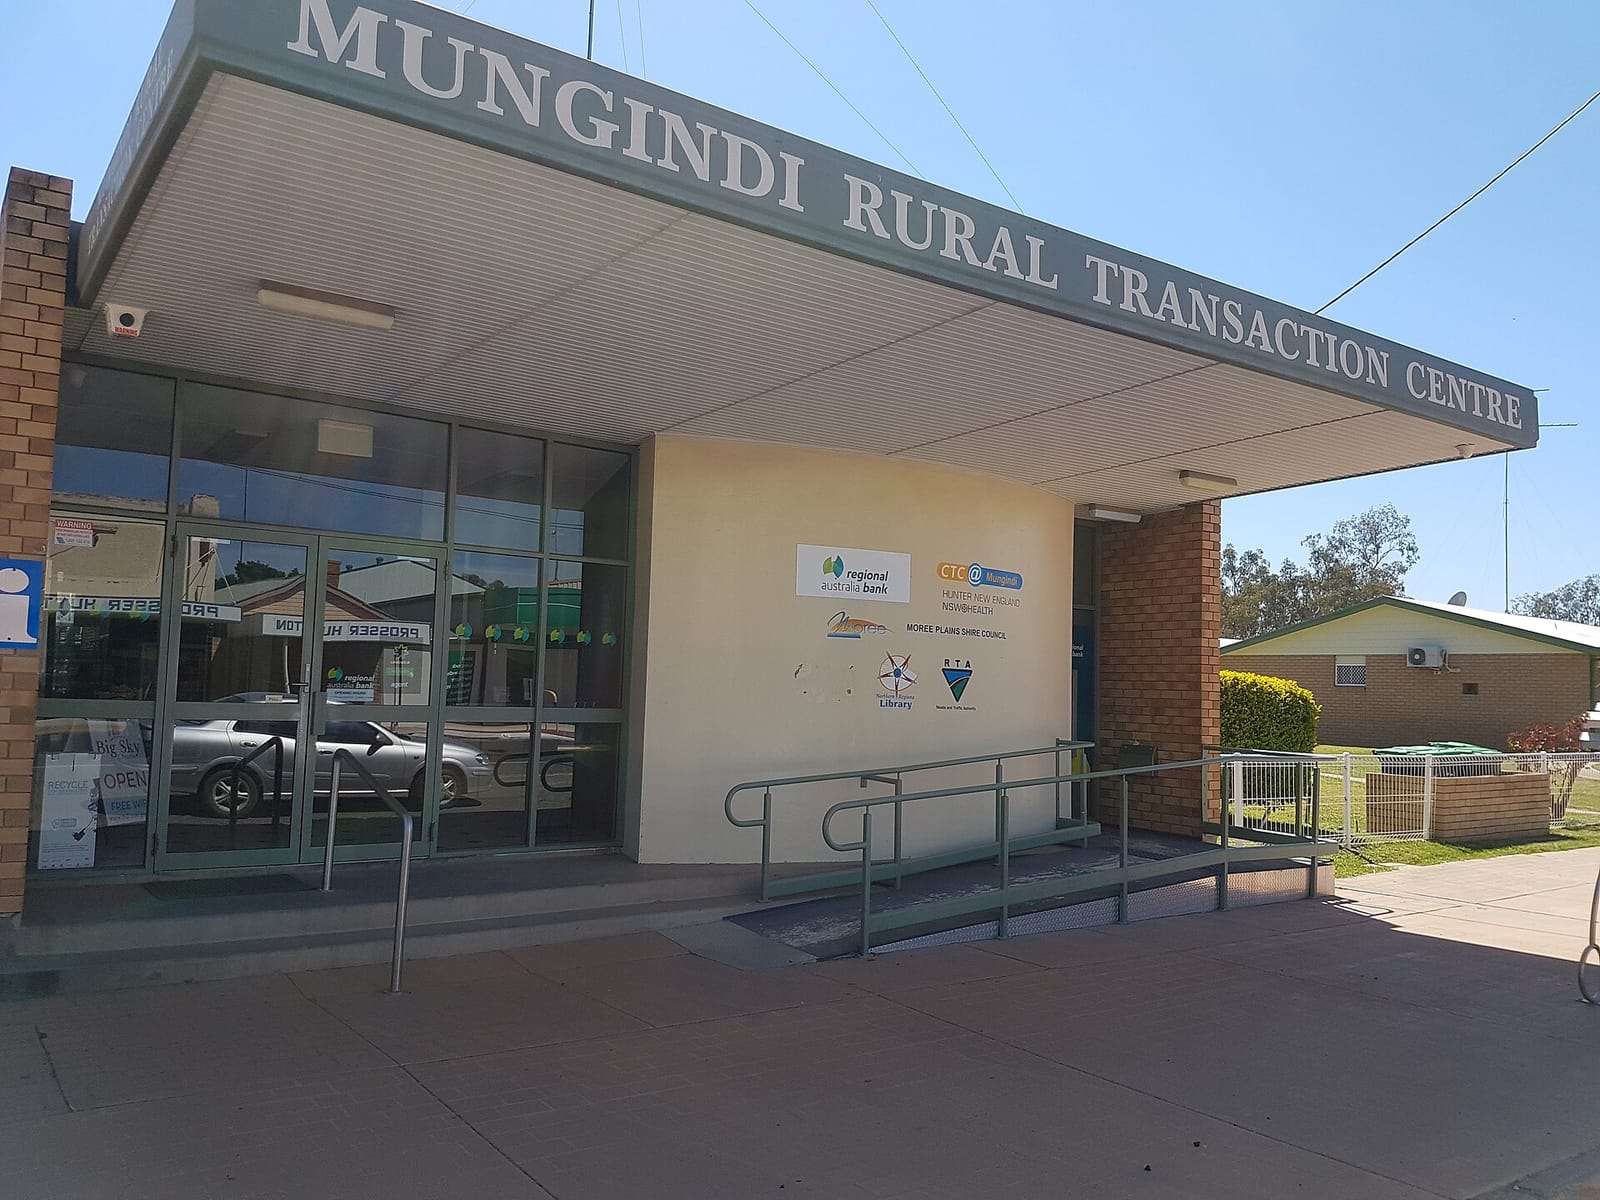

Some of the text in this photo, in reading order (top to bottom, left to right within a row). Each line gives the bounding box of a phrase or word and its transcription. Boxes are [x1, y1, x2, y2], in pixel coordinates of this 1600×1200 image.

[287, 0, 805, 213] MUNGINDI
[842, 173, 1059, 291] RURAL
[1084, 254, 1390, 388] TRANSACTION
[1405, 361, 1523, 429] CENTRE
[56, 520, 92, 530] WARNING
[846, 569, 889, 582] regional
[941, 564, 966, 580] CTC
[986, 572, 1018, 586] Mungindi
[821, 580, 888, 594] australia bank
[942, 590, 1020, 608] HUNTER NEW ENGLAND
[906, 624, 1007, 640] MOREE PLAINS SHIRE COUNCIL
[344, 674, 376, 682] regional
[880, 700, 912, 710] Library
[96, 738, 140, 758] Big Sky
[48, 780, 88, 790] RECYCLE
[104, 770, 147, 789] OPEN
